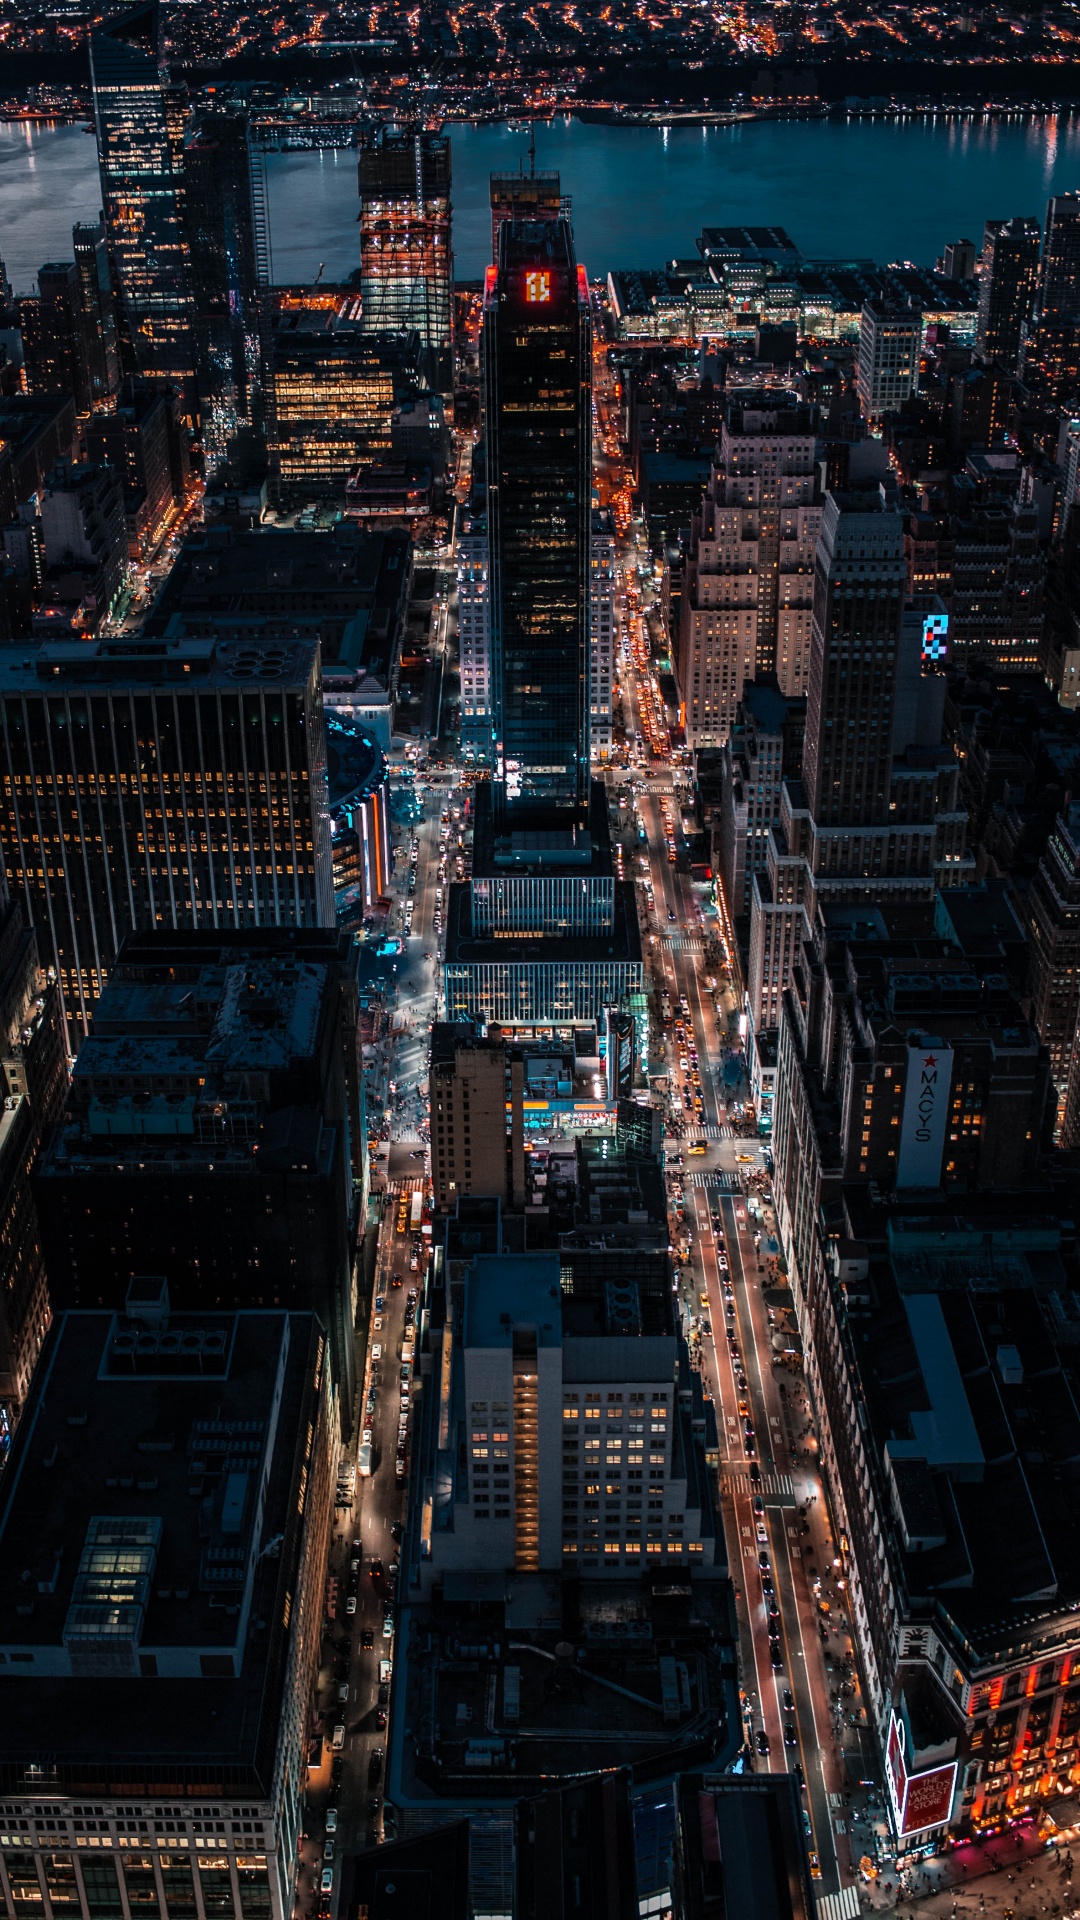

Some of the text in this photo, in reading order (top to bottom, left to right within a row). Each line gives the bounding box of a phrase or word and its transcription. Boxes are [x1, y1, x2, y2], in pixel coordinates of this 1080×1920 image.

[909, 1778, 951, 1798] WORLD'S
[922, 1775, 940, 1787] THE
[829, 1793, 843, 1807] ONLY
[908, 1787, 949, 1807] LARGEST
[914, 1796, 942, 1811] STORE
[835, 1819, 847, 1834] BUS
